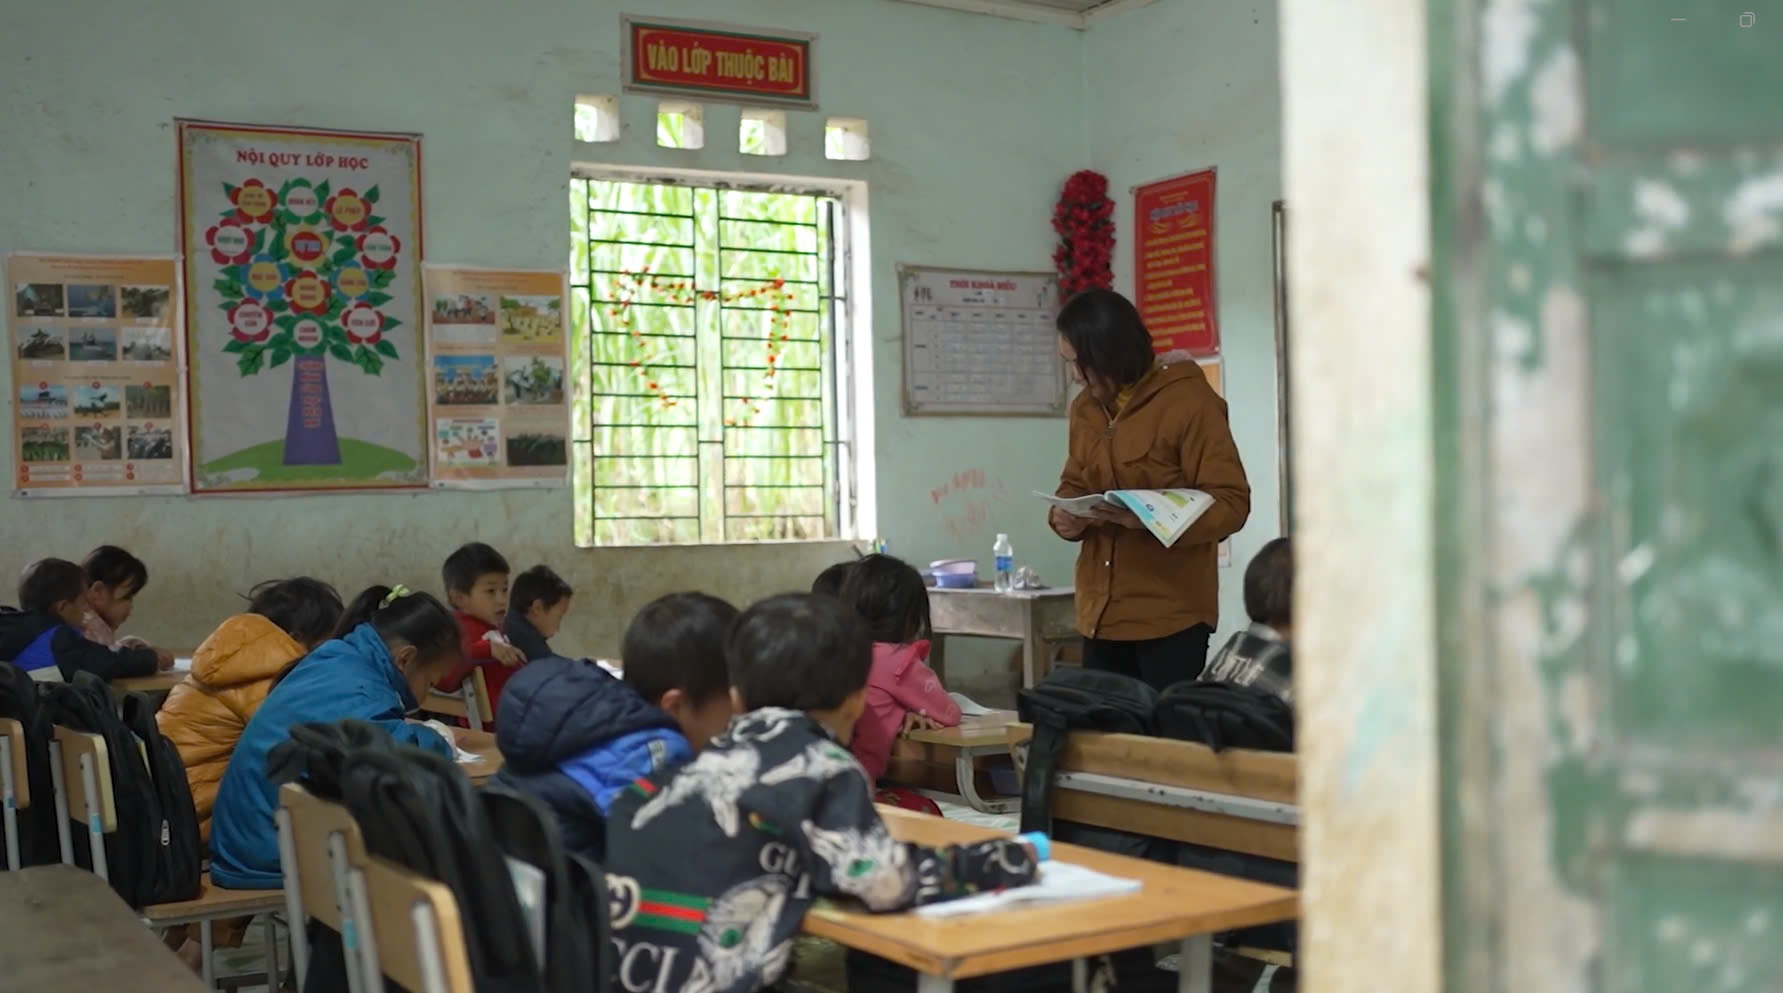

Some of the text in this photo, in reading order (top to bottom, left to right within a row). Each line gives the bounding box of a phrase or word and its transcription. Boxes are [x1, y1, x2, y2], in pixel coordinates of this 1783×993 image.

[647, 40, 793, 85] VÀO LỚP THUỘC BÀI
[237, 148, 368, 170] NỘI QUY LỚP HỌC
